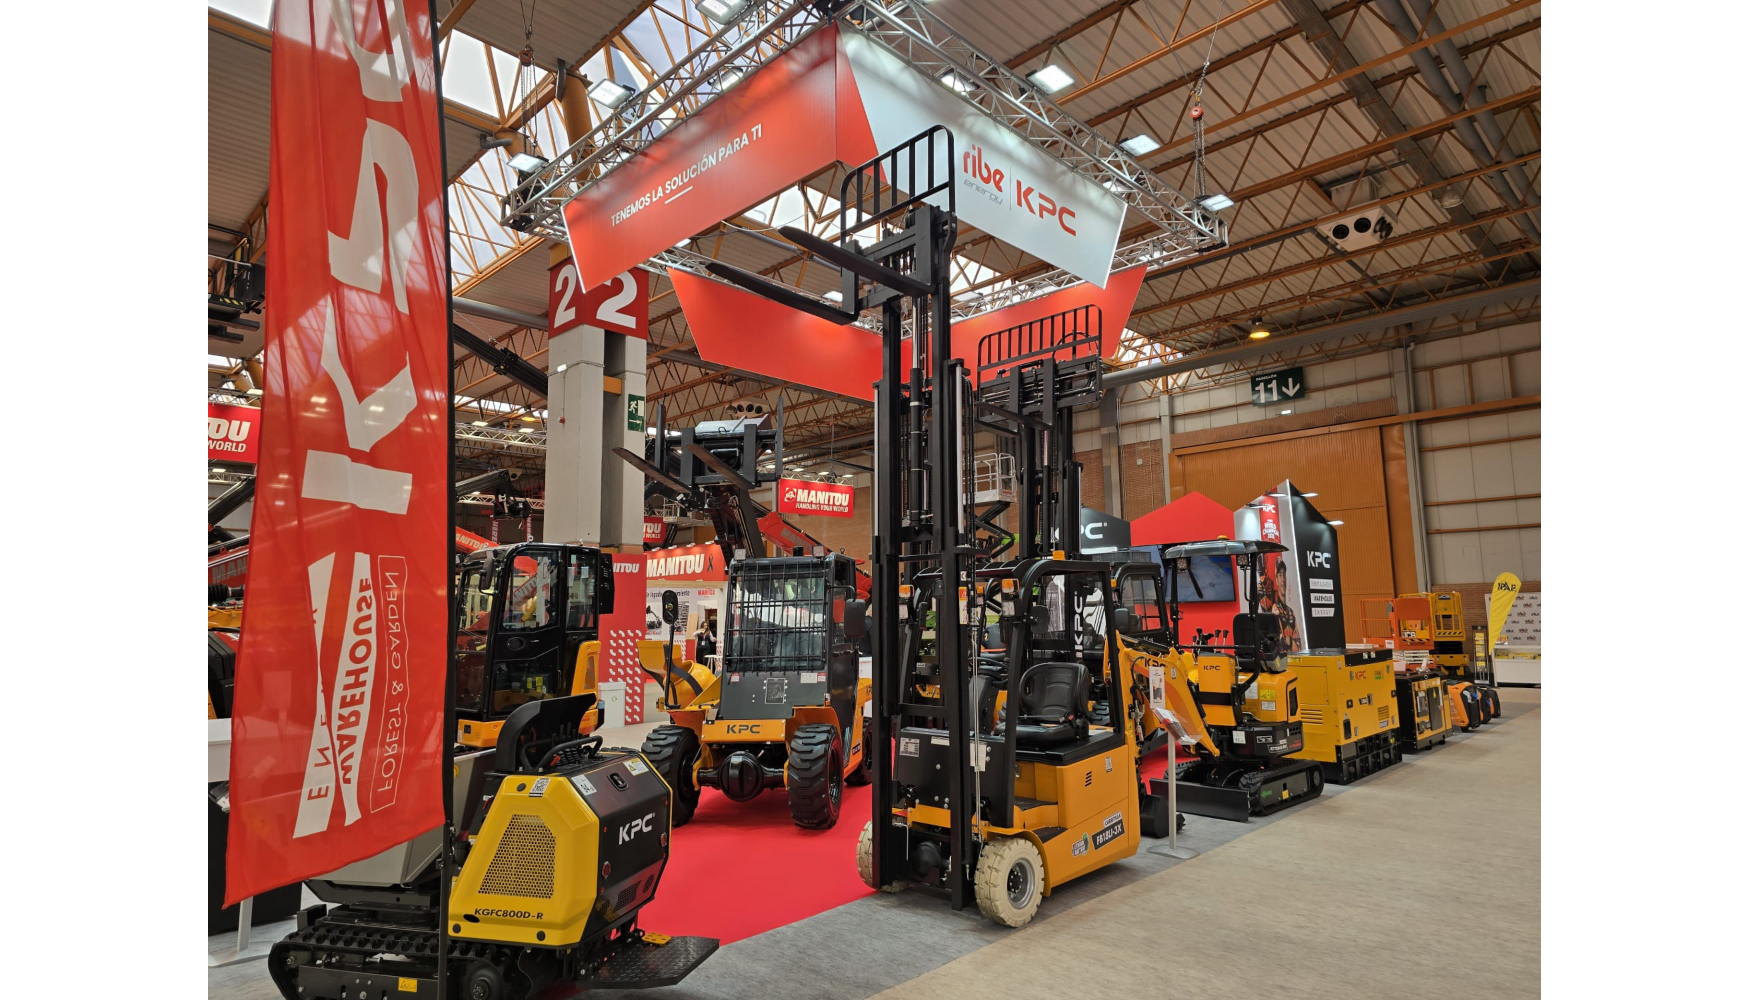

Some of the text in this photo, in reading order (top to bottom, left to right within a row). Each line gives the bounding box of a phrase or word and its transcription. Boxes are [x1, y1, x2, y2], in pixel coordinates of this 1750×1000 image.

[610, 123, 772, 227] TENEMOS LA SOLUCIÓN PARA TI
[963, 144, 1005, 193] ribe
[963, 179, 1003, 206] energy
[1016, 179, 1077, 237] KPC
[553, 264, 577, 328] 2
[596, 270, 638, 329] 2
[1255, 380, 1278, 403] 11
[208, 417, 251, 442] OU
[795, 502, 820, 511] HANDLING
[833, 505, 849, 513] WORLD
[796, 489, 850, 507] MANITOU
[643, 522, 662, 534] TOU
[211, 556, 248, 584] MAN
[612, 562, 640, 574] ITOU
[646, 554, 705, 578] MANITOU
[1306, 550, 1332, 569] KPC
[1074, 594, 1083, 651] KPC
[1355, 670, 1367, 681] KPC
[726, 724, 762, 734] KPC
[618, 814, 654, 845] KPC
[474, 907, 544, 920] KGFC800D-R
